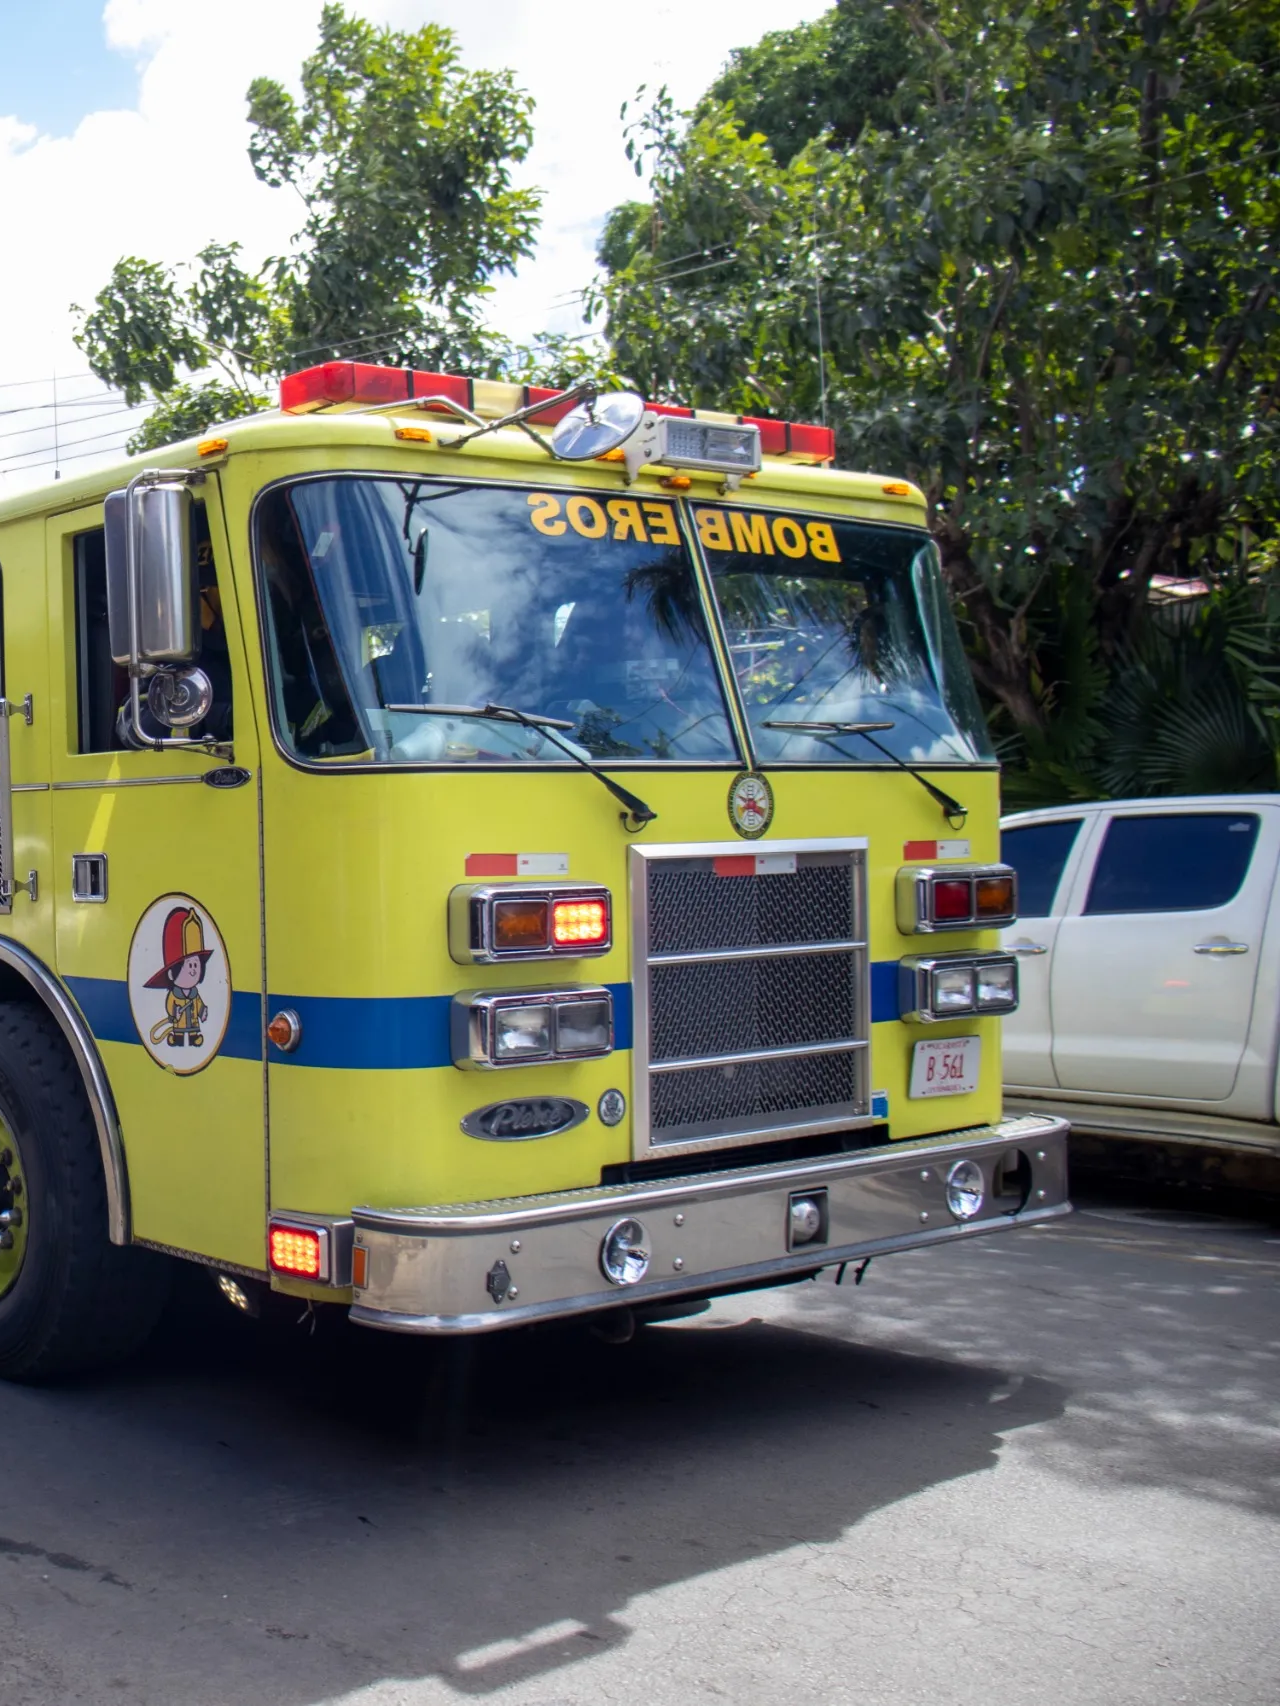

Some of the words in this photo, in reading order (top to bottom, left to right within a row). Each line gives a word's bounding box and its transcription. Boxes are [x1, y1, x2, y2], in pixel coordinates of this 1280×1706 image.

[926, 1056, 936, 1082] B
[940, 1053, 964, 1080] 561
[489, 1102, 562, 1136] Pierce
